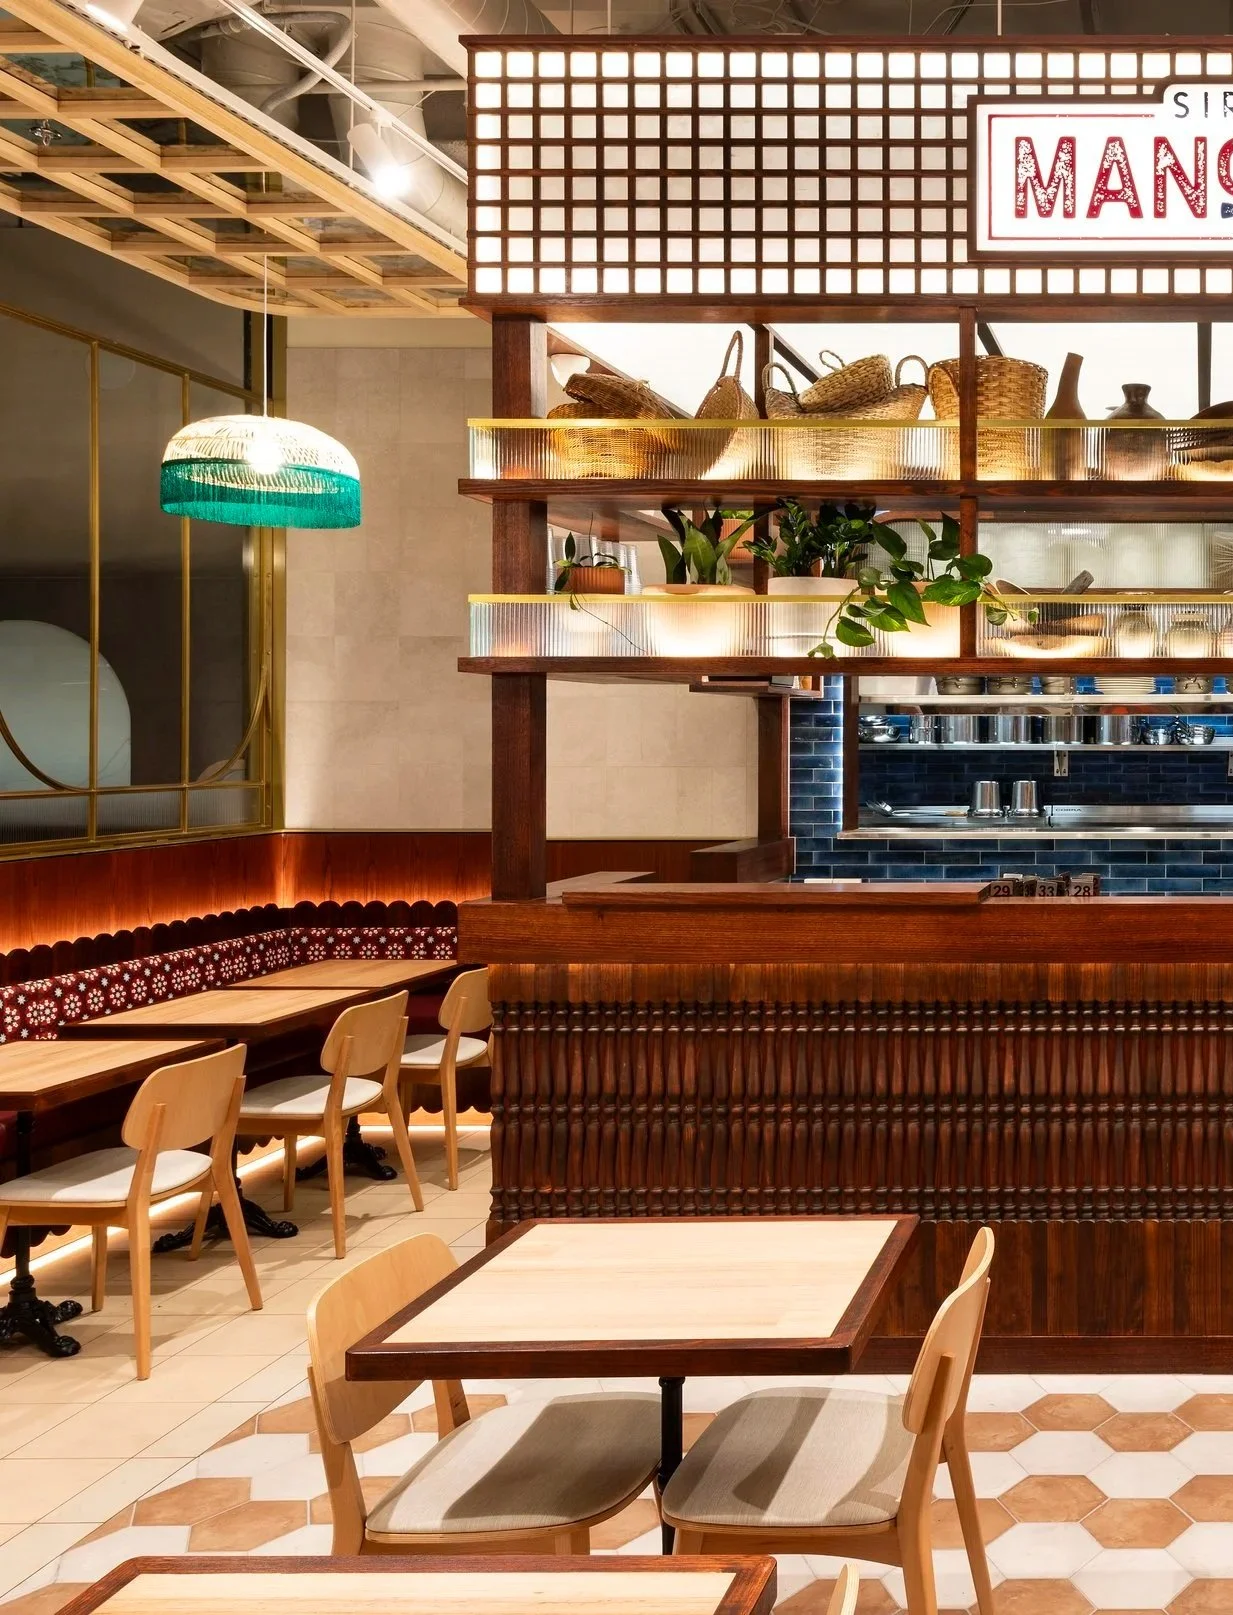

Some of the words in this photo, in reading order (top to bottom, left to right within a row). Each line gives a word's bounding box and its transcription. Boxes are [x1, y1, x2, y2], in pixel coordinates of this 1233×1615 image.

[993, 885, 1011, 896] 29
[1039, 885, 1055, 896] 33
[1073, 885, 1091, 896] 28
